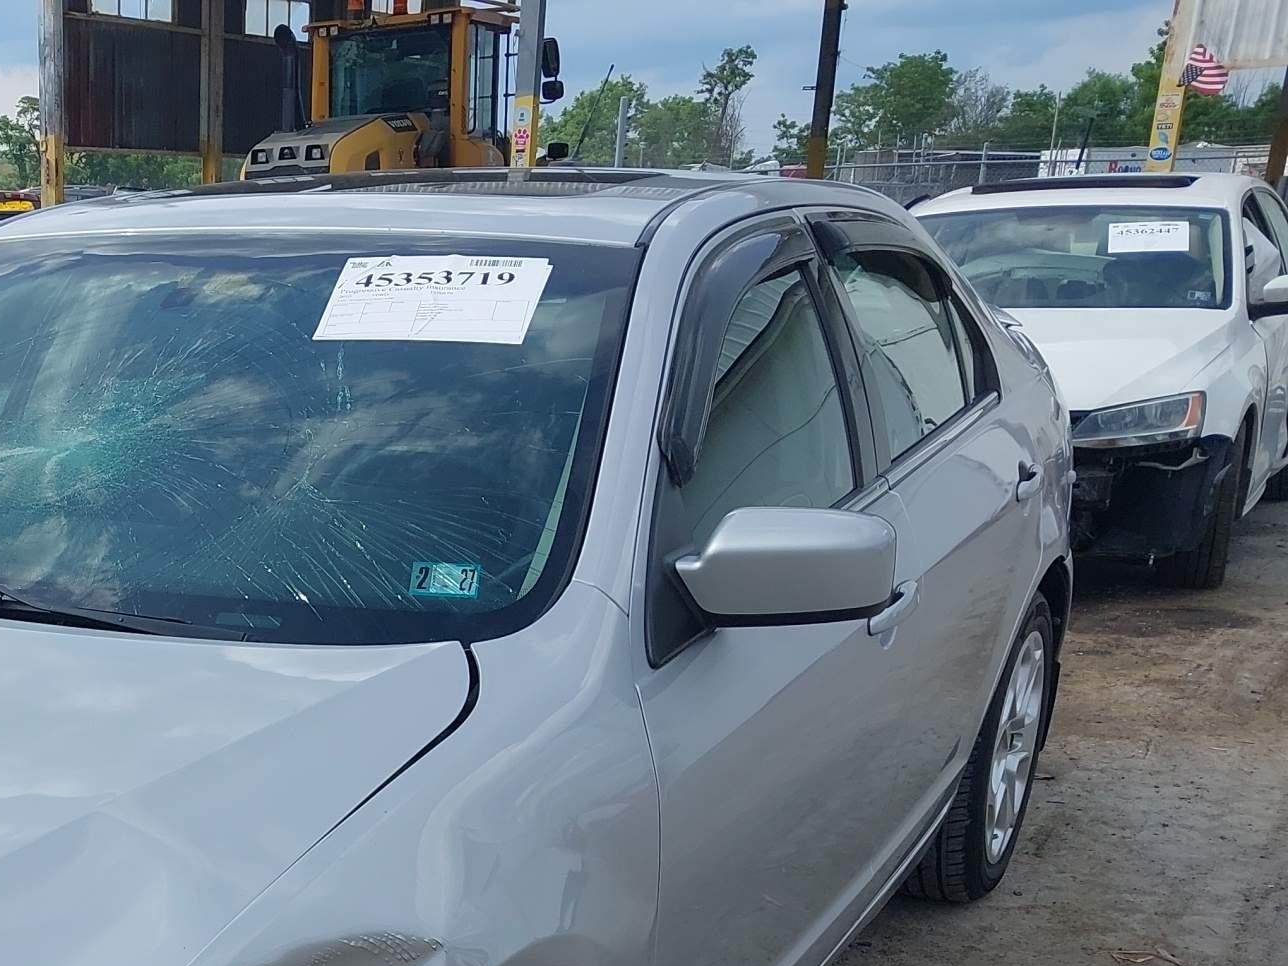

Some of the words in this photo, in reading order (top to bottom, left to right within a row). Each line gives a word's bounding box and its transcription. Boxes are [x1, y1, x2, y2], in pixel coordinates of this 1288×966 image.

[355, 270, 517, 288] 45353719
[416, 566, 430, 589] 2
[459, 568, 475, 591] 27
